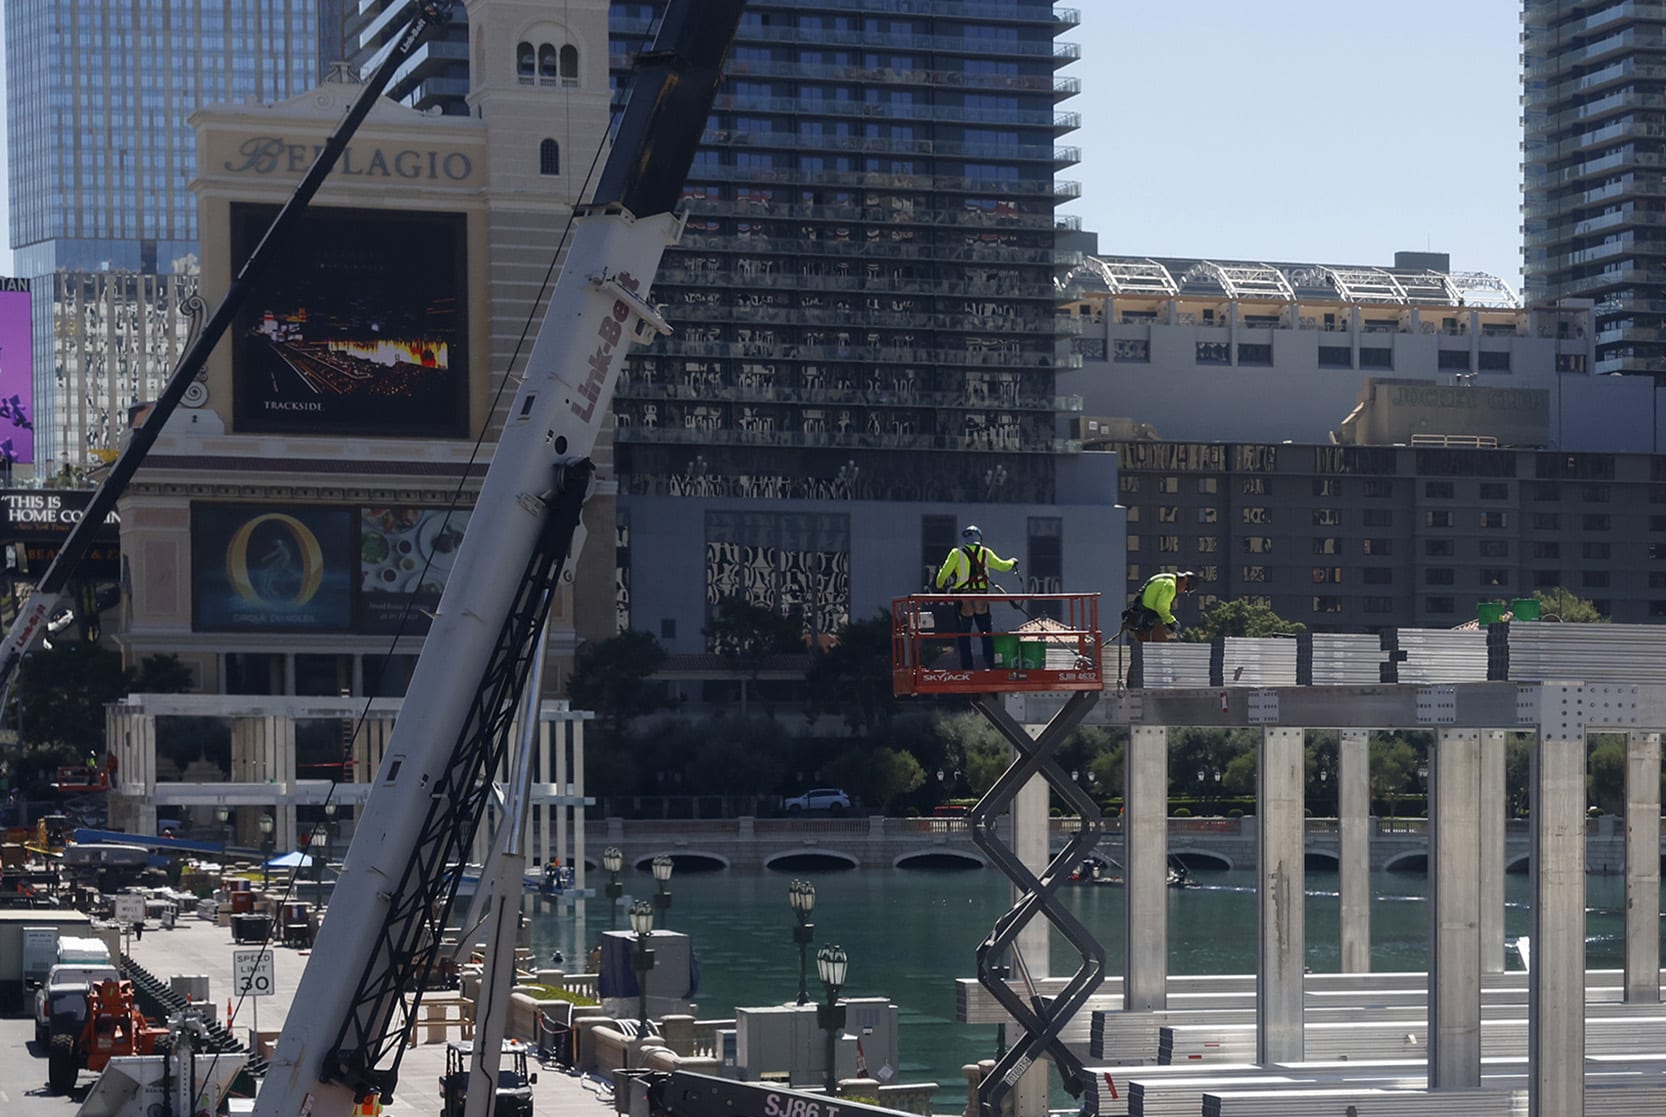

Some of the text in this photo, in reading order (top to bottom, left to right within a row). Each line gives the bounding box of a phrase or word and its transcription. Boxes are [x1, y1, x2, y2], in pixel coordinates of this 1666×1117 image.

[224, 136, 472, 180] BELAGIO
[570, 271, 640, 424] Link-Bet
[47, 495, 61, 509] IS
[8, 509, 57, 522] HOME
[923, 670, 971, 682] SKYJACK
[240, 976, 269, 990] 30
